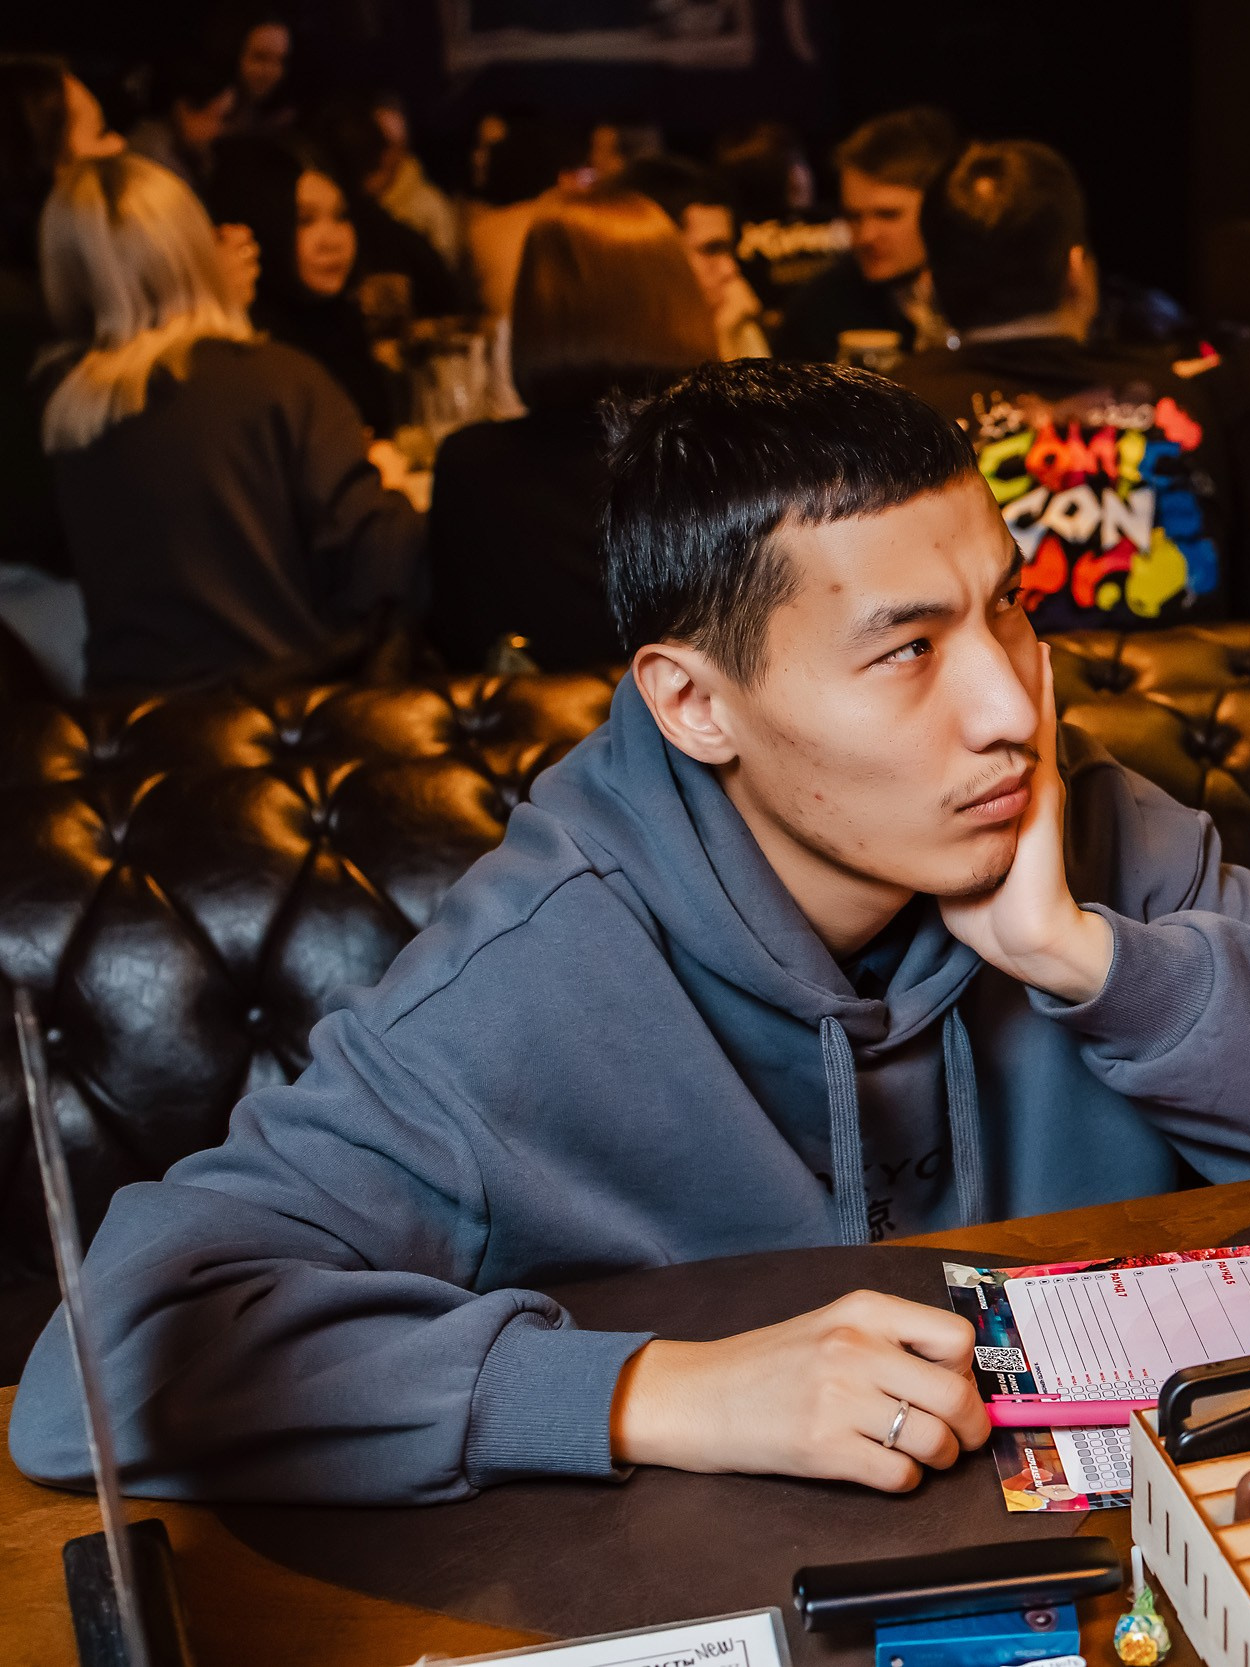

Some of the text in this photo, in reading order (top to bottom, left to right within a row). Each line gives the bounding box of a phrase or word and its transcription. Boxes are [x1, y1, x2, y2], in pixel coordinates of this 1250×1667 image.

[1001, 484, 1156, 563] CON
[1217, 1262, 1232, 1281] РАУНД
[1110, 1273, 1123, 1294] РАУНД
